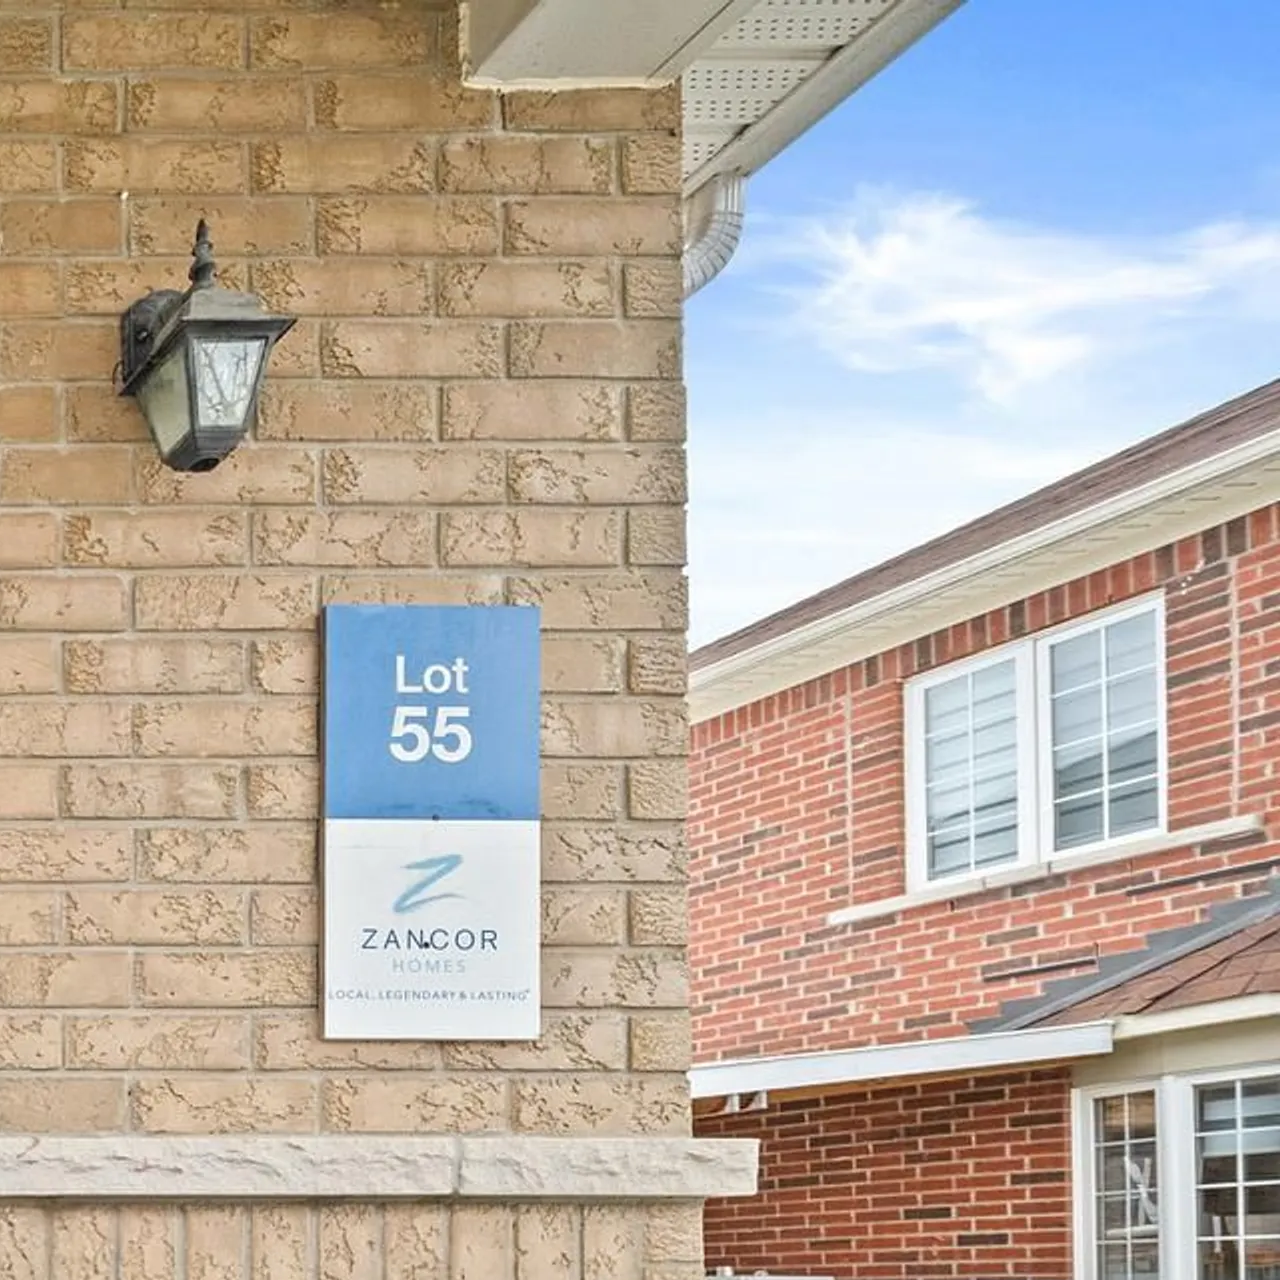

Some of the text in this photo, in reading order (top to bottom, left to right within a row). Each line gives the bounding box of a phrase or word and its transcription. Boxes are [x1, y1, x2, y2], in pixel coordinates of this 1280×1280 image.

[395, 655, 470, 694] Lot
[390, 705, 473, 763] 55
[361, 928, 499, 951] ZANCOR
[392, 959, 467, 974] HOMES
[378, 989, 455, 1001] LEGENDARY
